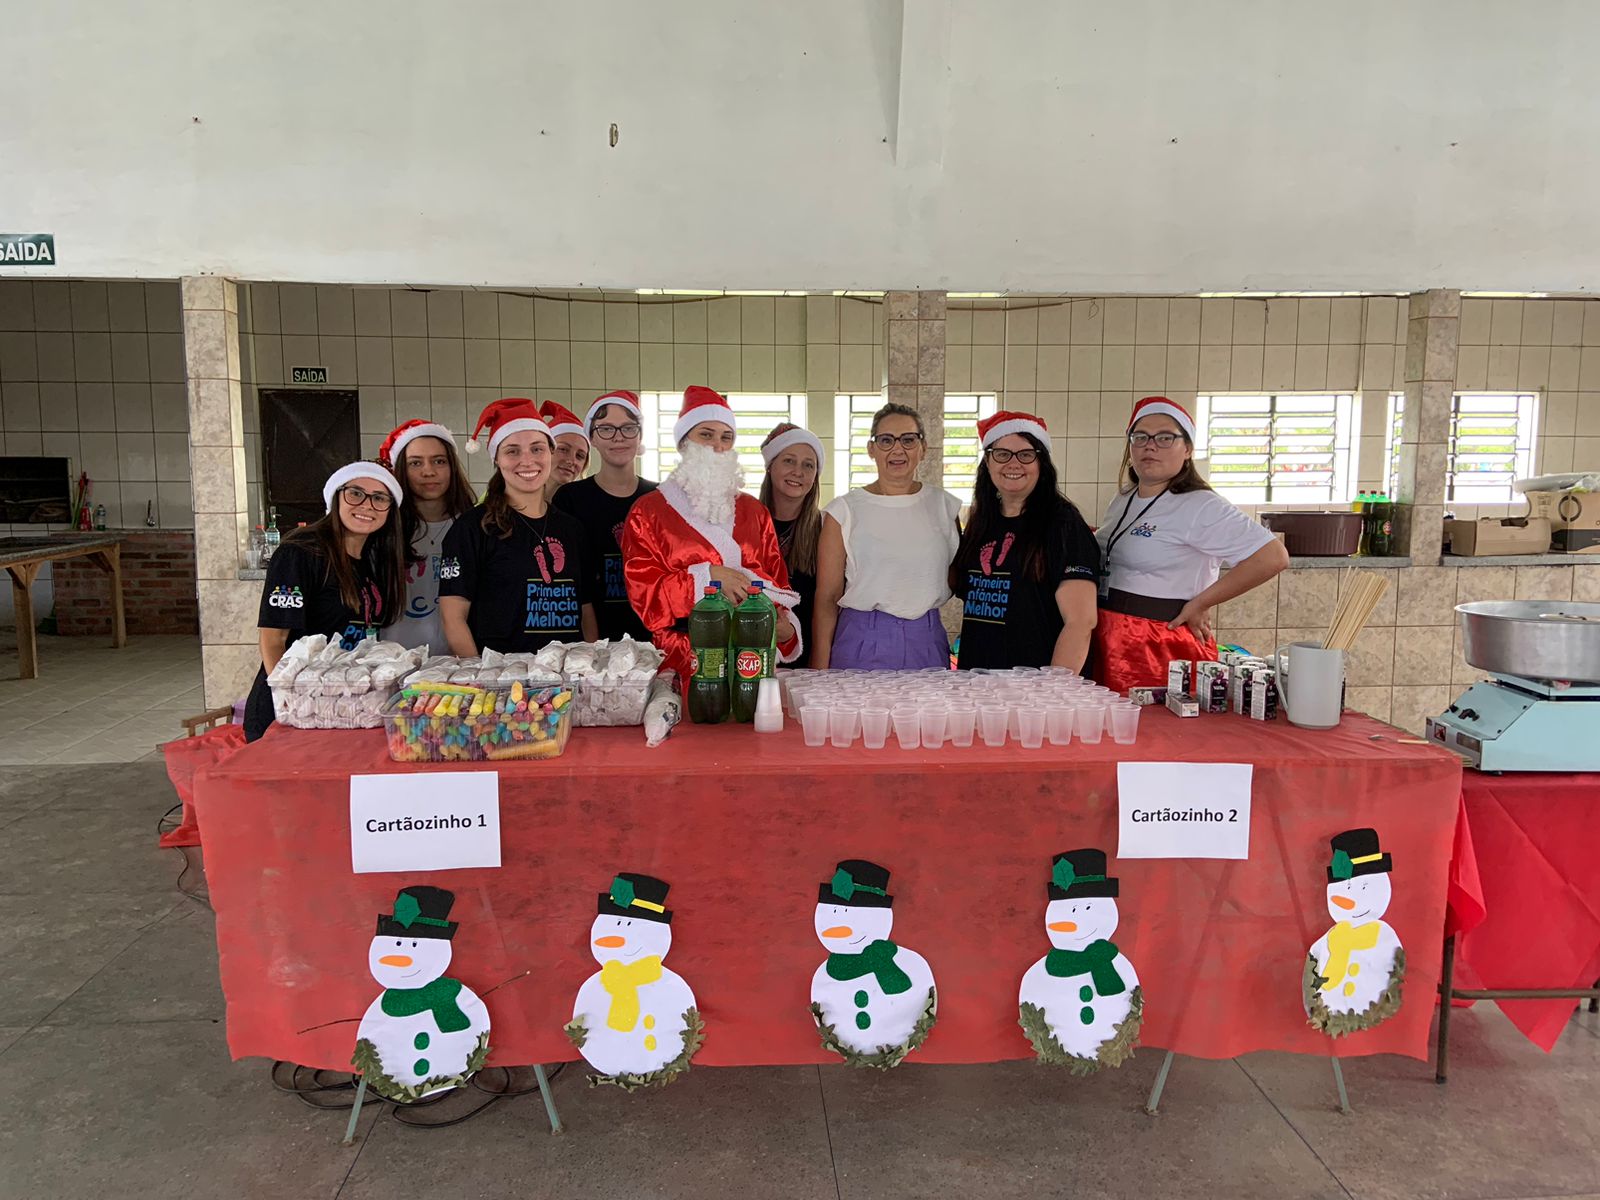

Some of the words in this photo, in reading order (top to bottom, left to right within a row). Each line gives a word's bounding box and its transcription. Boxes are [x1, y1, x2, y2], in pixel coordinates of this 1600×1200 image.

[294, 369, 326, 382] SAÍDA
[269, 594, 304, 608] CRAS
[968, 588, 1009, 604] nfância
[526, 597, 578, 612] Infância
[964, 599, 1007, 618] Melhor
[525, 611, 579, 628] Melhor
[737, 658, 761, 672] SKAP
[1131, 807, 1224, 822] Cartãozinho
[1228, 809, 1238, 822] 2
[366, 814, 472, 832] Cartãozinho
[477, 813, 487, 827] 1
